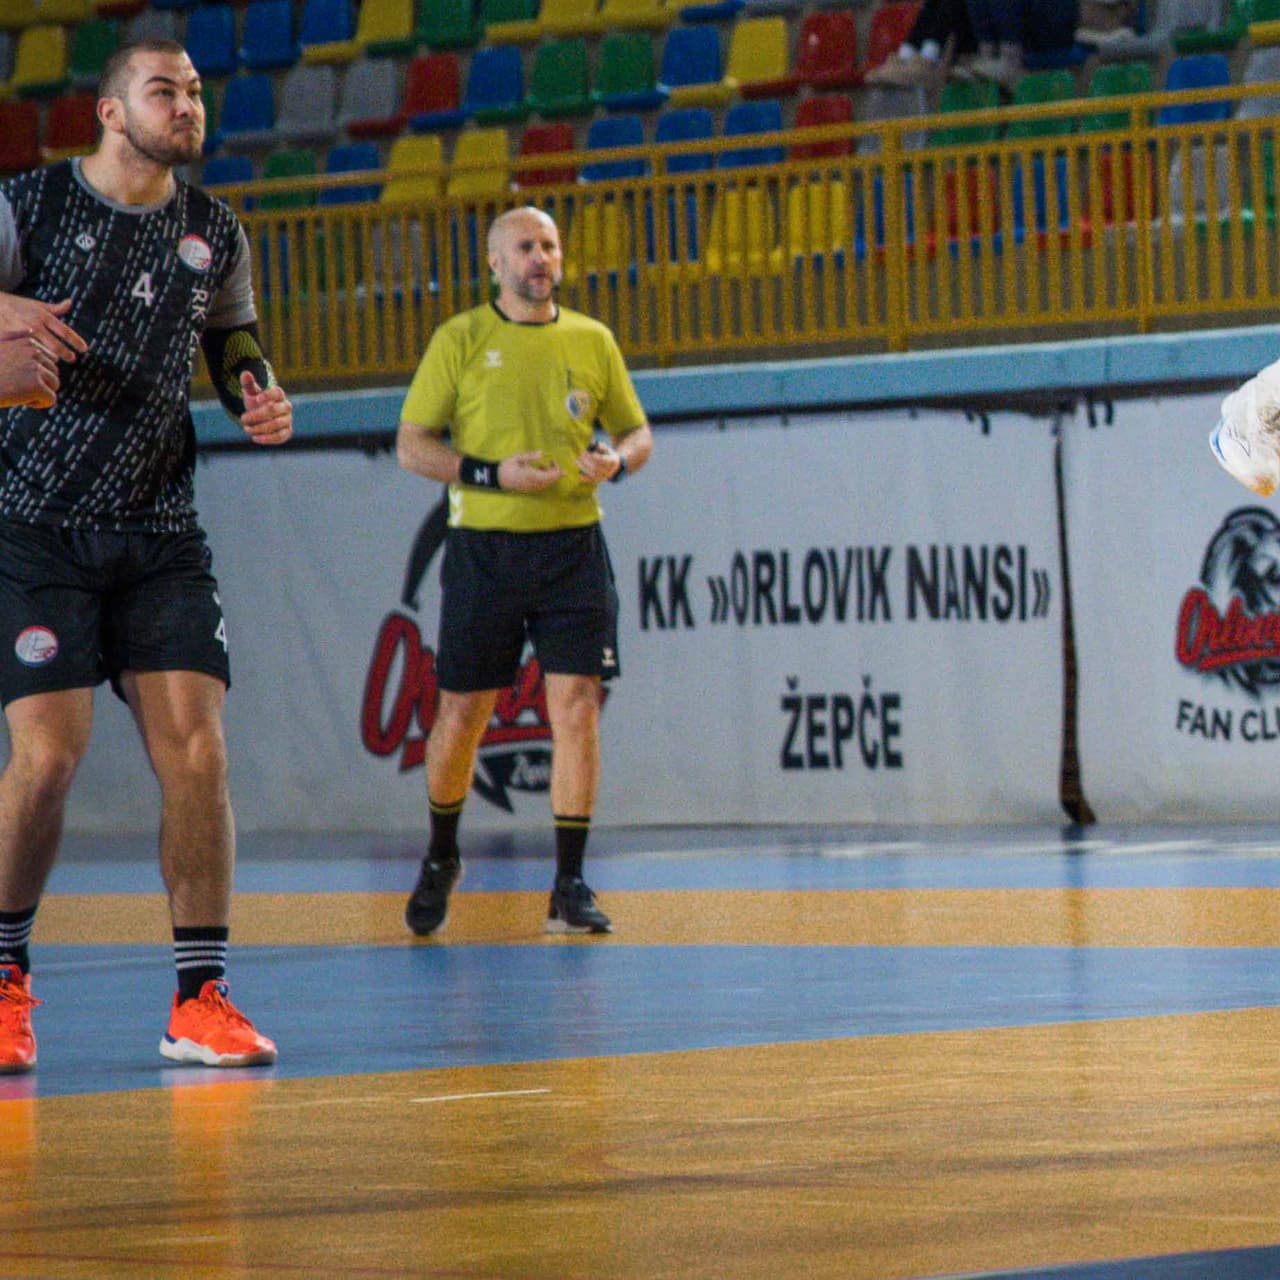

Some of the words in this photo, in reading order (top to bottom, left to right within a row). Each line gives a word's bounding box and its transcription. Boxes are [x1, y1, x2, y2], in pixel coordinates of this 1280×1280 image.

[131, 271, 154, 307] 4
[191, 287, 208, 321] RK
[638, 554, 695, 630] KK
[214, 617, 228, 653] 4
[780, 674, 903, 770] ŽEPČE
[1176, 699, 1233, 742] FAN
